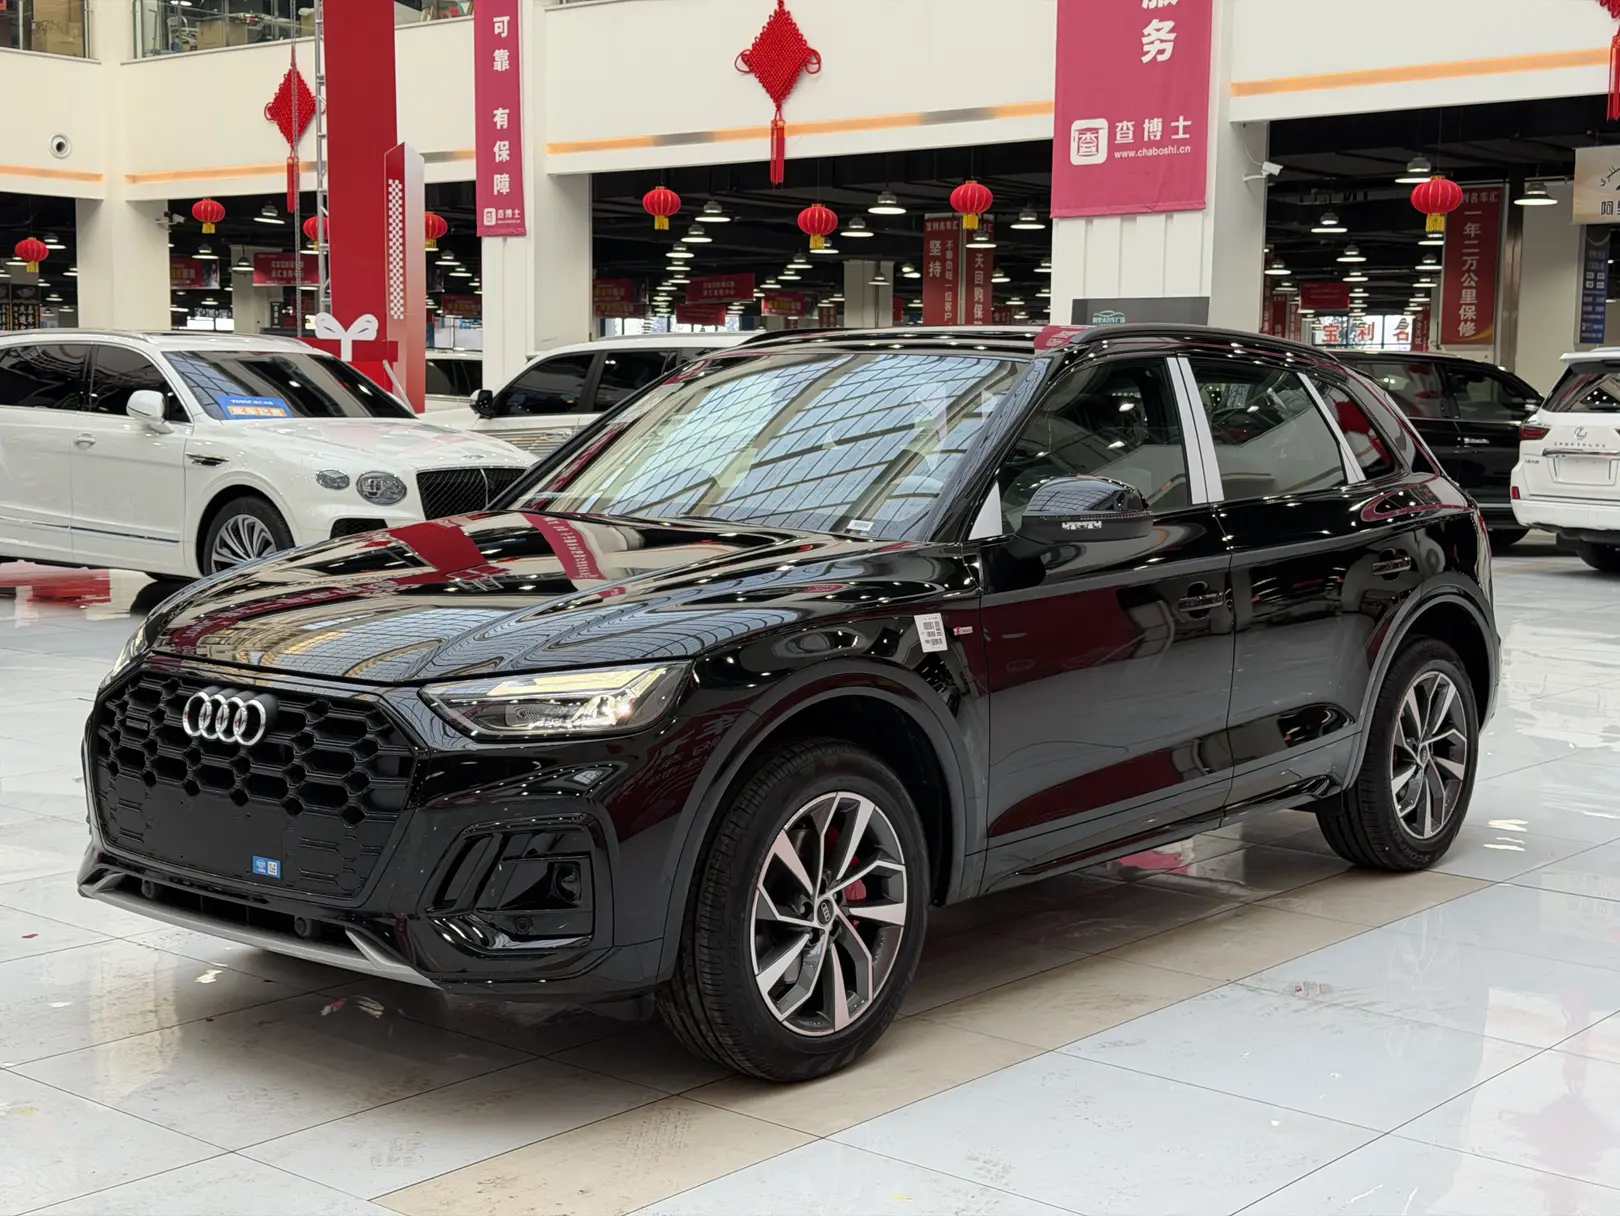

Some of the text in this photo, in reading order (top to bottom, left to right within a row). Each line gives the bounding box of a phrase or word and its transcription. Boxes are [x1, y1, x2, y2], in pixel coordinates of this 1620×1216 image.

[1141, 0, 1178, 64] 务
[493, 16, 511, 196] 可靠 有保障
[1114, 116, 1192, 144] 查博士
[1114, 145, 1191, 158] www.chaboshi.cn
[928, 240, 942, 278] 坚持
[973, 253, 984, 325] 天回购保
[1458, 210, 1482, 337] 一年二万公里保修
